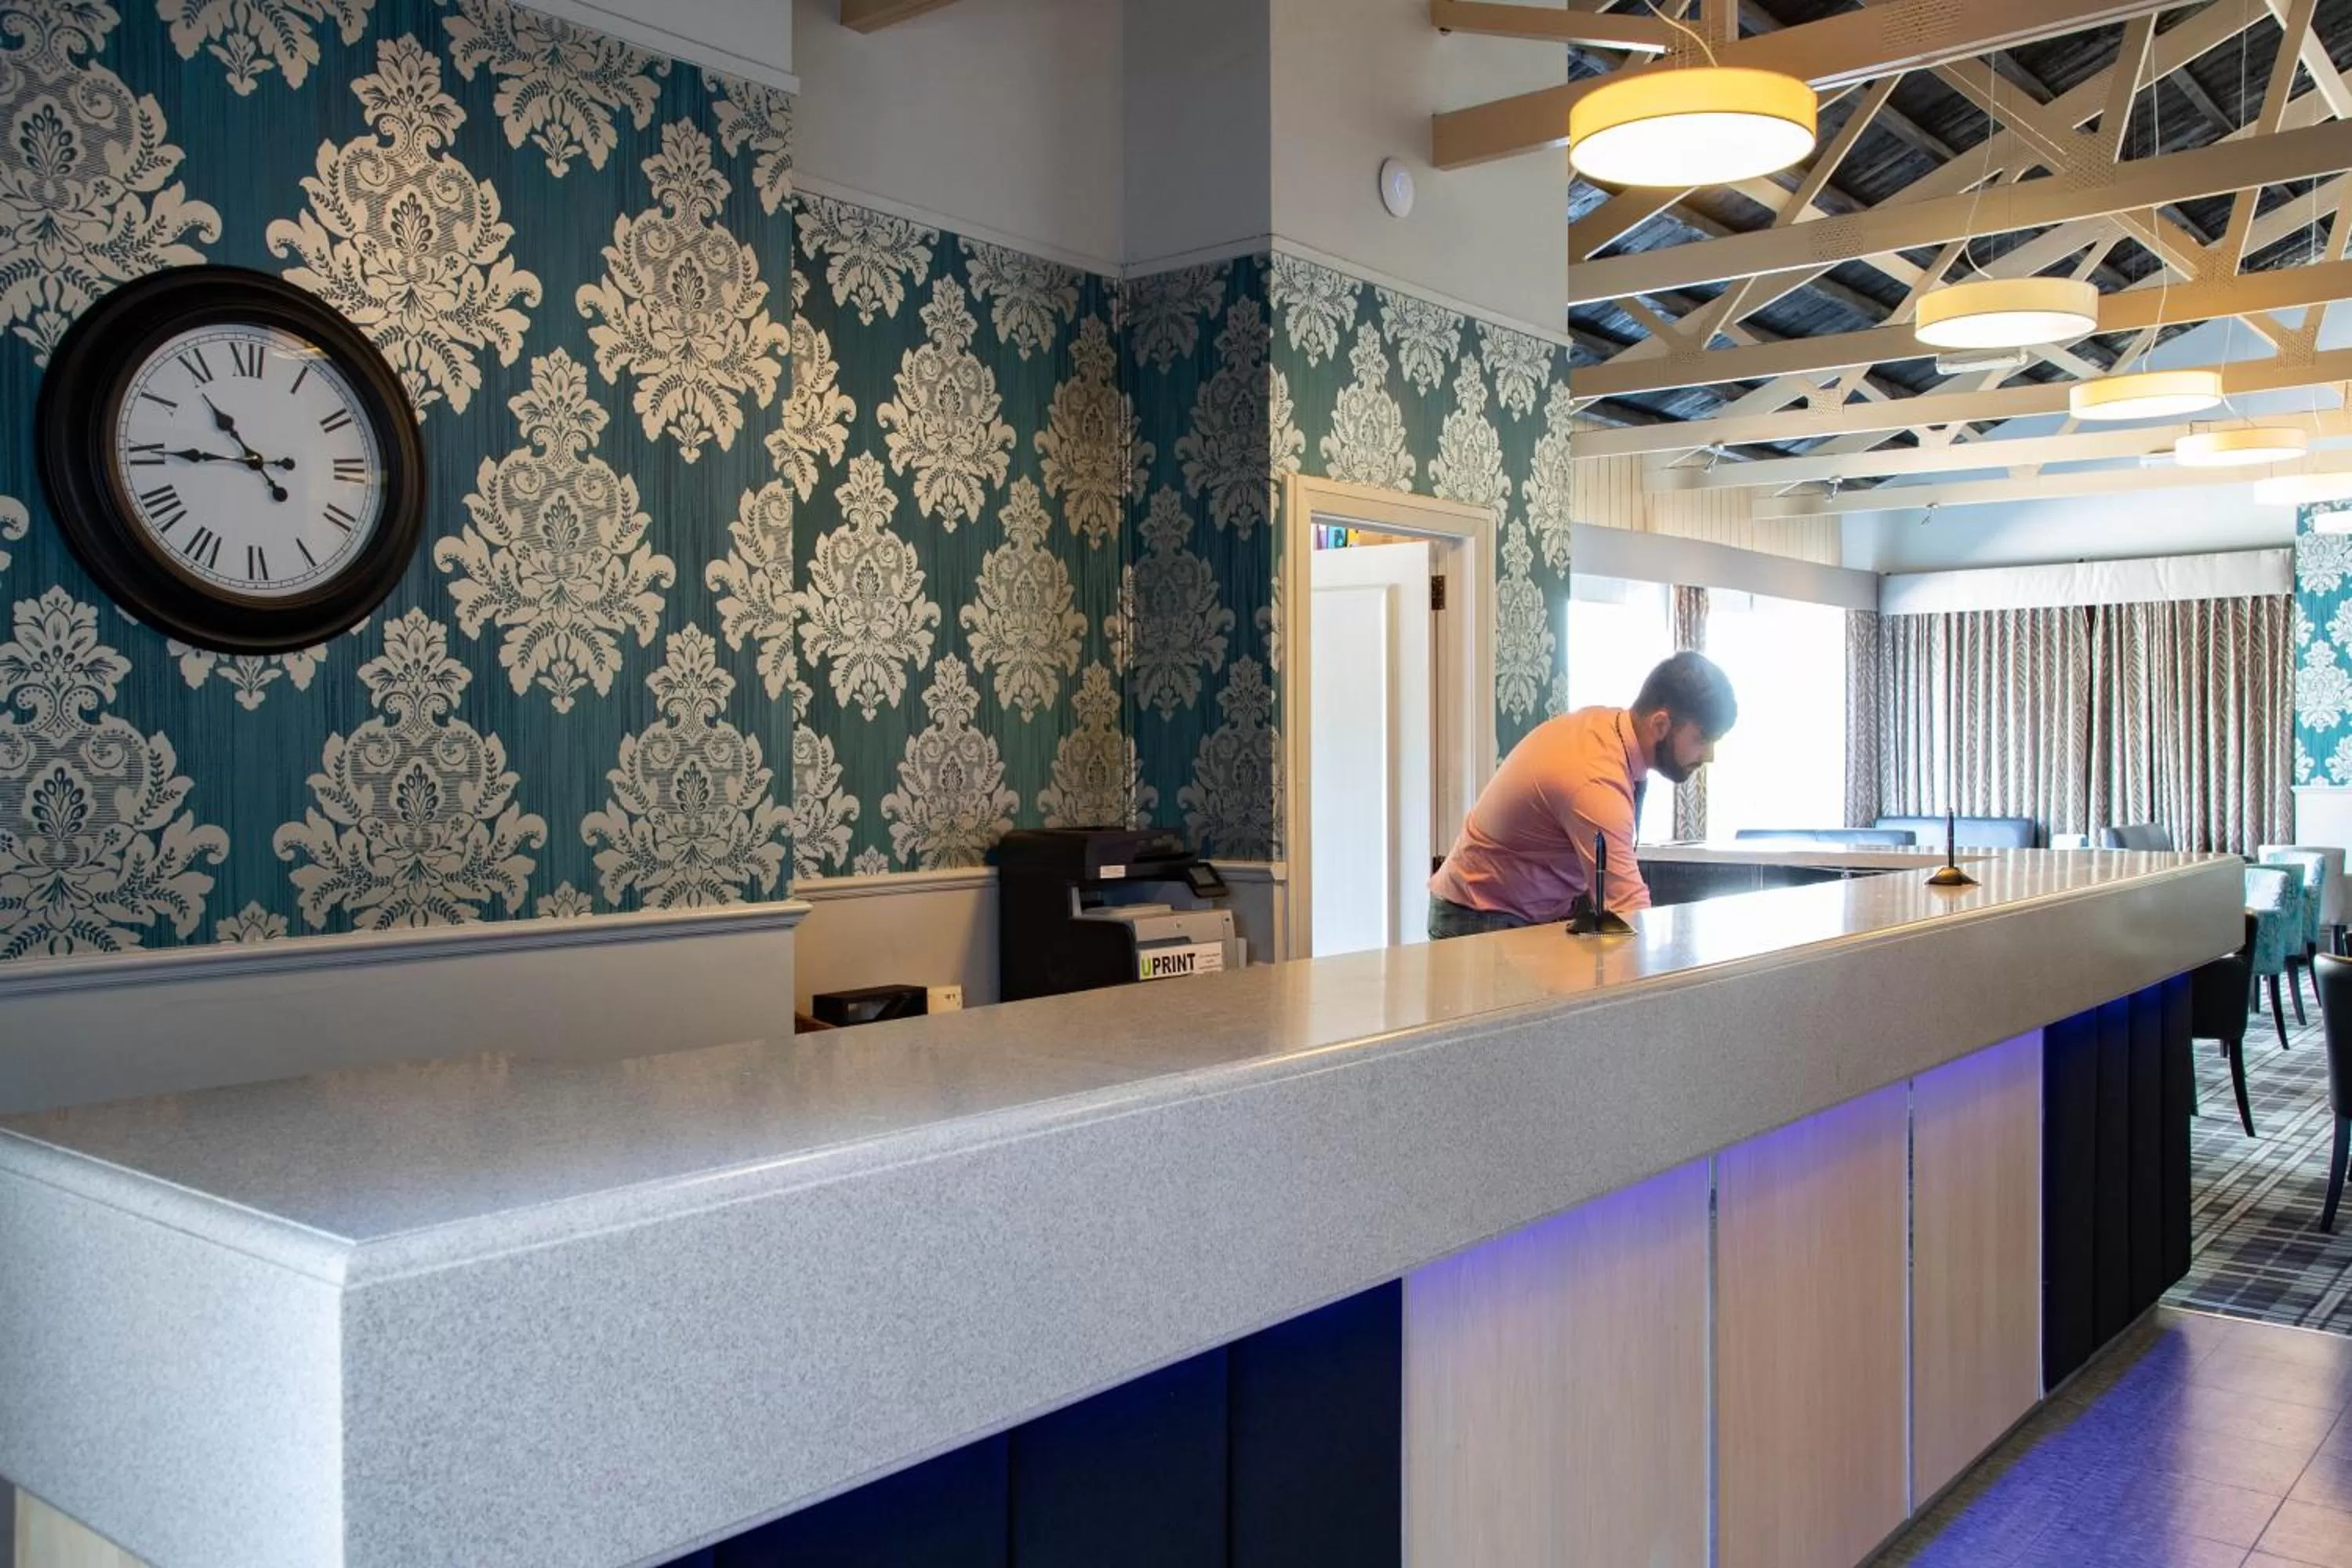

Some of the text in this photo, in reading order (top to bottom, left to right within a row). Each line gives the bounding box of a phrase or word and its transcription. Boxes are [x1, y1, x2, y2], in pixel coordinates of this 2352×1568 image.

[177, 347, 213, 389] XI
[228, 341, 266, 379] XII
[291, 365, 309, 394] I
[140, 383, 178, 418] X
[320, 408, 353, 434] II
[128, 439, 165, 466] IX
[333, 458, 365, 484] III
[140, 485, 187, 533] VIII
[323, 503, 357, 536] IV
[183, 526, 223, 570] VII
[247, 545, 269, 581] VI
[295, 537, 317, 570] V
[1141, 953, 1196, 977] UPRINT
